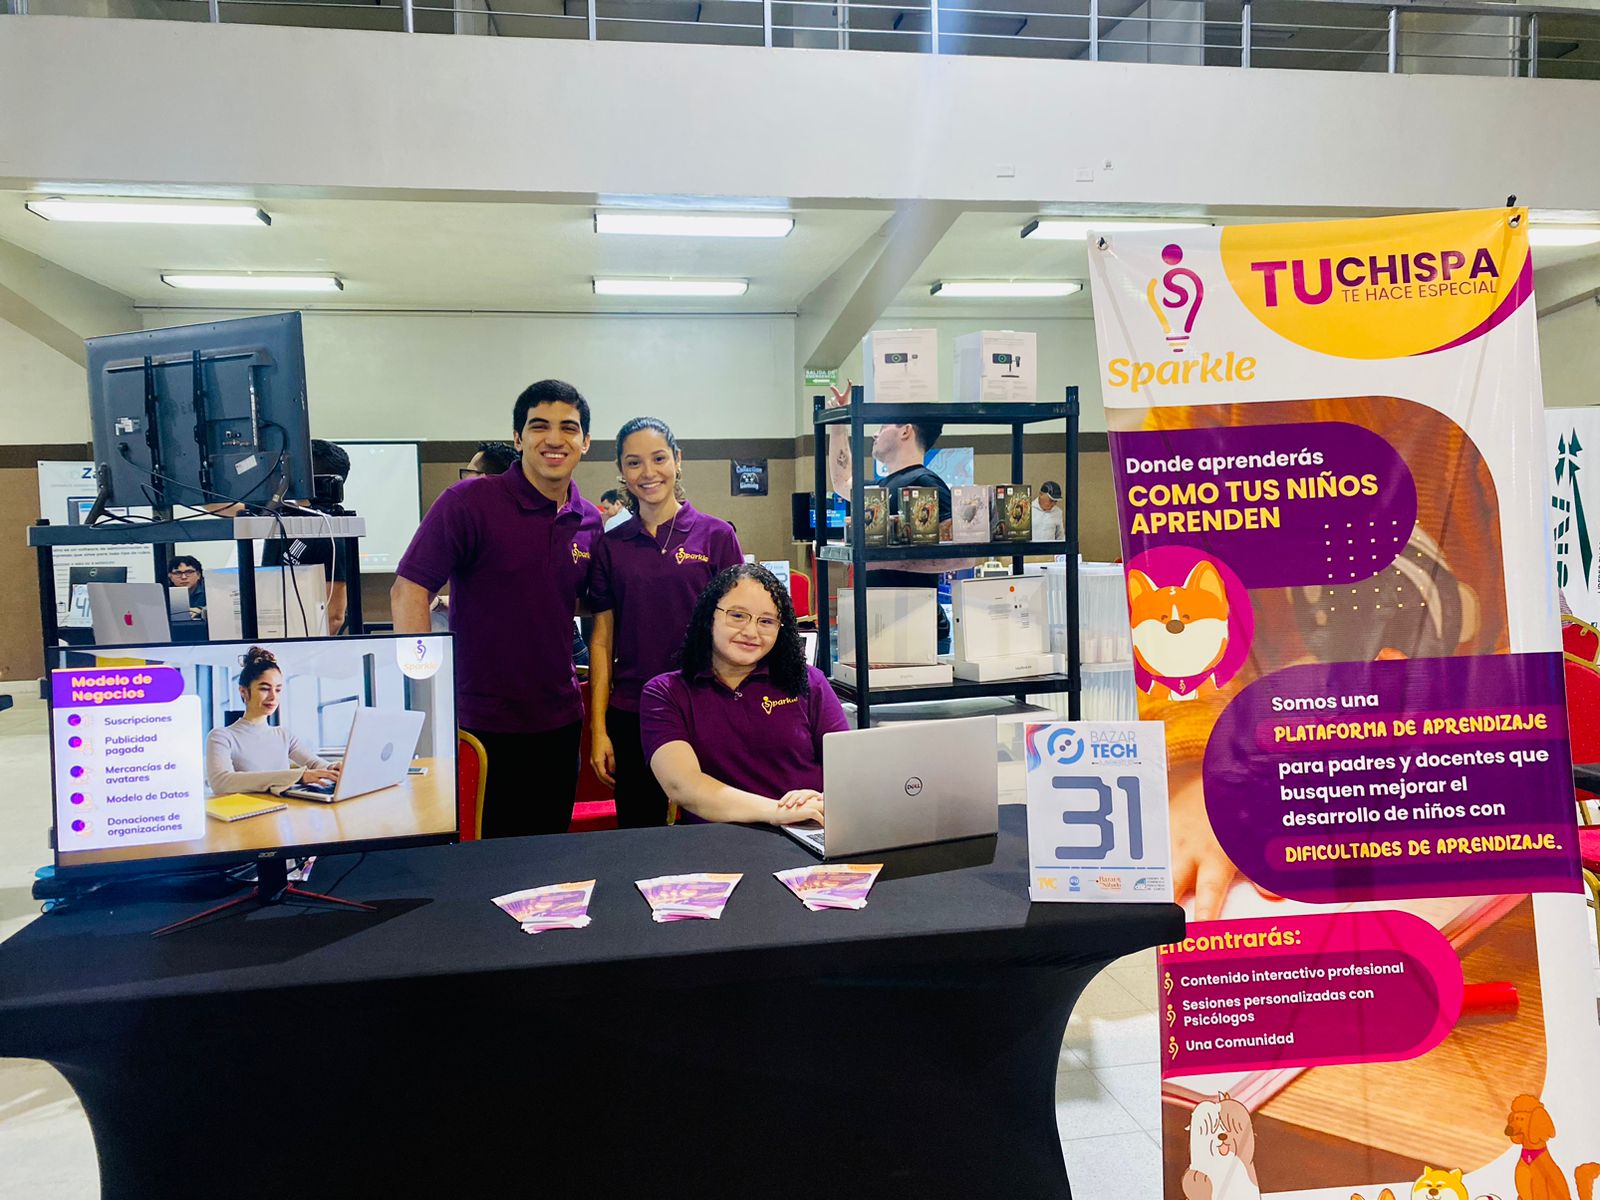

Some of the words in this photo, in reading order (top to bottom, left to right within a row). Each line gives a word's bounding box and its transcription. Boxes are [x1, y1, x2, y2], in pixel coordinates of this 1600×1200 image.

[1250, 258, 1334, 307] TU
[1336, 248, 1499, 287] CHISPA
[1342, 288, 1361, 303] TE
[1366, 285, 1413, 301] HACE
[1419, 280, 1497, 298] ESPECIAL
[1107, 352, 1256, 393] Sparkle
[1126, 456, 1193, 474] Donde
[1198, 448, 1324, 476] aprenderás
[1128, 483, 1219, 508] COMO
[1226, 479, 1280, 503] TUS
[1288, 471, 1378, 500] NIÑOS
[1130, 507, 1281, 535] APRENDEN
[675, 550, 709, 564] Sparkle
[71, 674, 130, 688] Modelo
[132, 673, 153, 685] de
[72, 687, 145, 704] Negocios
[1271, 695, 1337, 712] Somos
[1341, 694, 1379, 709] una
[104, 715, 172, 727] Suscripciones
[1273, 720, 1387, 743] PLATAFORMA
[1393, 719, 1417, 737] DE
[1423, 713, 1548, 736] APRENDIZAJE
[105, 734, 157, 745] Publicidad
[1090, 730, 1136, 743] BAZAR
[105, 745, 144, 756] pagada
[1091, 744, 1137, 759] TECH
[106, 762, 162, 775] Mercancías
[164, 761, 176, 771] de
[1278, 760, 1324, 780] para
[1328, 754, 1396, 776] padres
[1399, 757, 1412, 774] y
[1415, 748, 1505, 768] docentes
[1509, 749, 1549, 765] que
[106, 775, 150, 785] avatares
[1279, 783, 1365, 803] busquen
[1369, 778, 1447, 800] mejorar
[1450, 776, 1467, 792] el
[106, 793, 142, 804] Modelo
[146, 792, 157, 802] de
[160, 790, 189, 800] Datos
[108, 815, 166, 826] Donaciones
[168, 813, 180, 822] de
[1052, 776, 1143, 860] 31
[1282, 807, 1380, 827] desarrollo
[1384, 806, 1408, 822] de
[1412, 803, 1465, 820] niños
[1469, 801, 1505, 817] con
[108, 822, 182, 837] organizaciones
[1285, 840, 1401, 863] DIFICULTADES
[1407, 839, 1431, 855] DE
[1436, 834, 1562, 856] APRENDIZAJE.
[1180, 970, 1249, 988] Contenido
[1252, 967, 1325, 985] interactivo
[1328, 961, 1404, 980] profesional
[1182, 995, 1241, 1012] Sesiones
[1244, 990, 1346, 1010] personalizadas
[1349, 988, 1375, 1000] con
[1184, 1011, 1255, 1028] Psicólogos
[1185, 1037, 1212, 1052] Una
[1215, 1032, 1295, 1050] Comunidad
